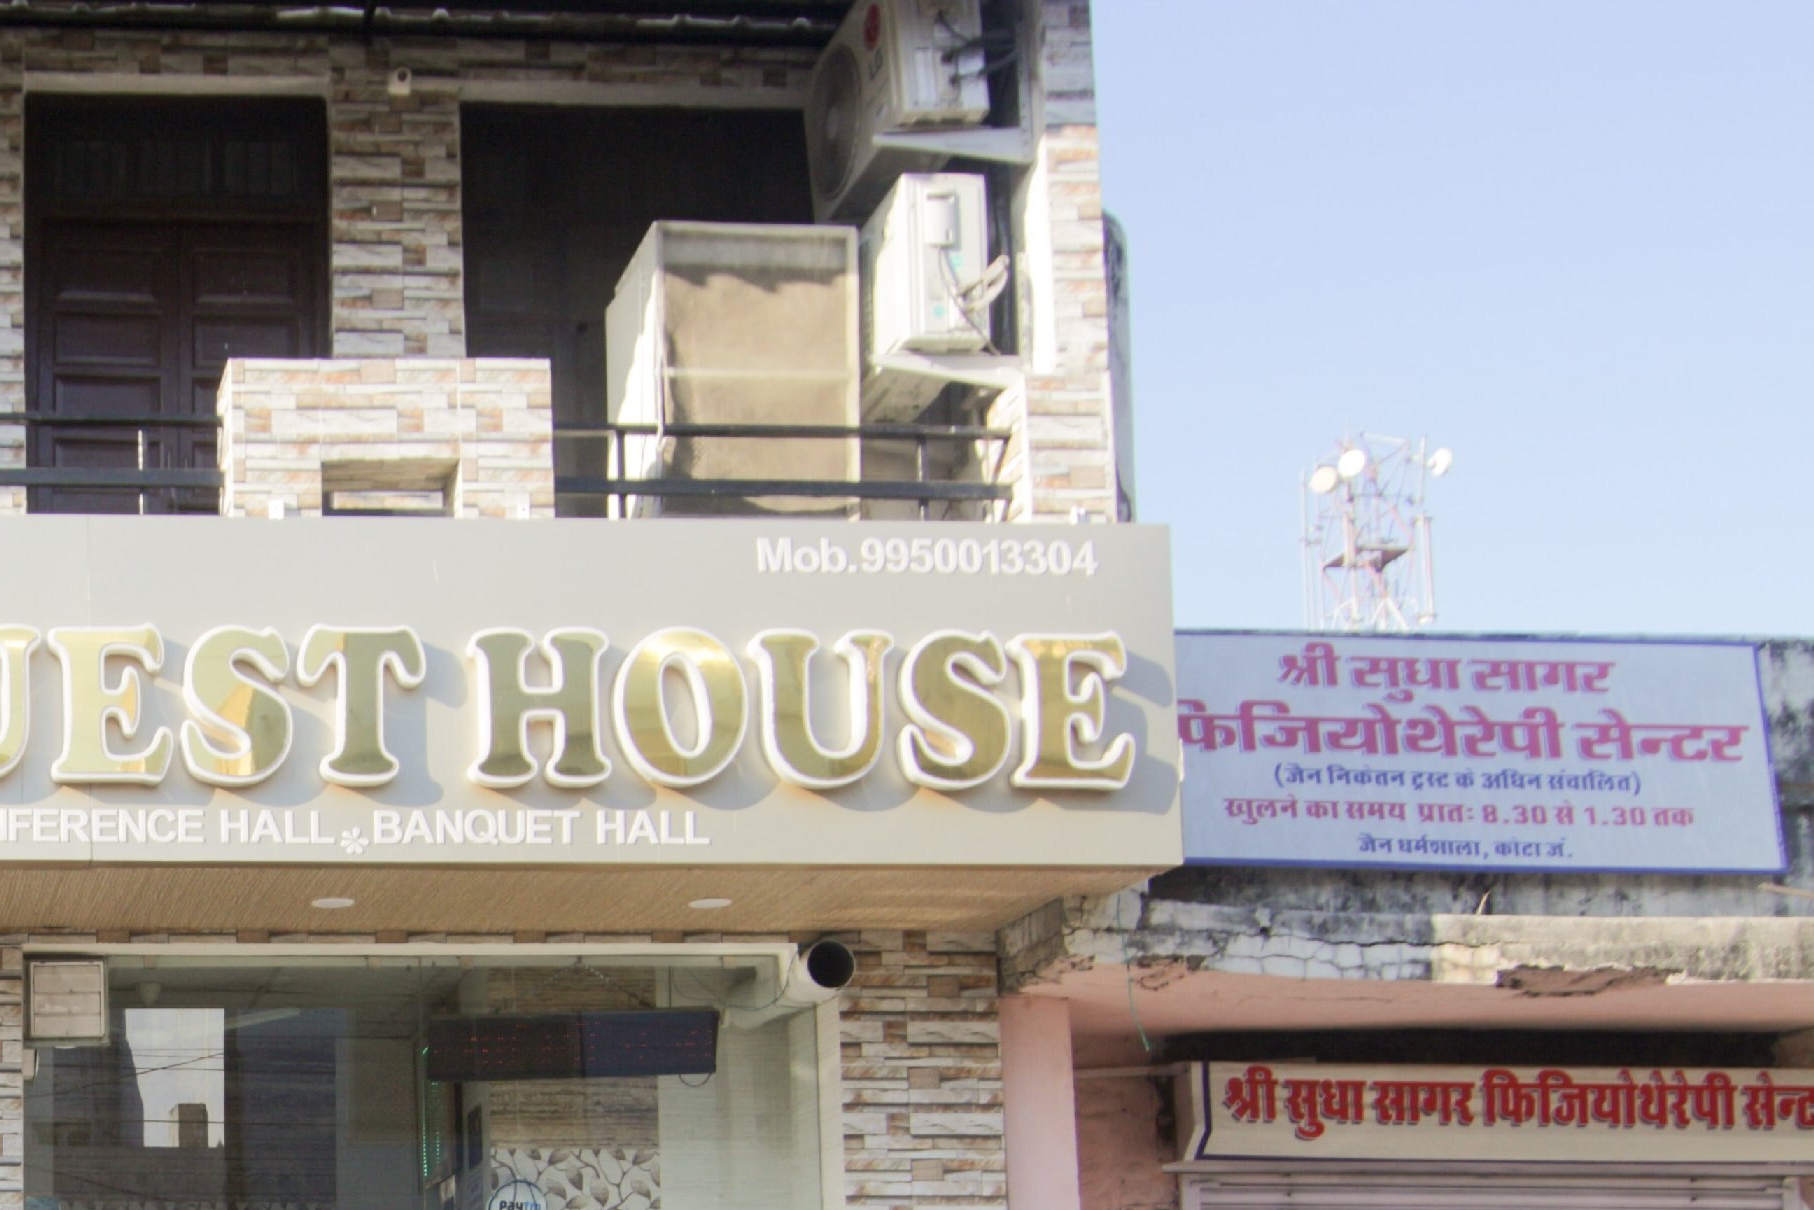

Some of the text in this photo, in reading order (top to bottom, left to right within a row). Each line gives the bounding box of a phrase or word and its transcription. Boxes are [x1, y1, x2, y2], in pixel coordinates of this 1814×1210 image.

[1277, 641, 1616, 703] श्री सुधा सागर
[467, 626, 1136, 793] HOUSE
[1573, 707, 1749, 762] सेन्टर
[220, 809, 335, 844] HALL
[373, 810, 580, 845] BANQUET
[596, 810, 711, 845] HALL
[1224, 794, 1298, 825] खुलने
[1304, 800, 1339, 818] का
[1346, 801, 1406, 821] समय
[1482, 804, 1547, 825] 8.30
[1553, 800, 1575, 825] से
[1584, 806, 1646, 826] 1.30
[1651, 807, 1695, 826] तक
[1358, 832, 1392, 853] जैन
[1494, 836, 1541, 857] कोटा
[1222, 1065, 1279, 1123] श्री
[1282, 1078, 1367, 1140] सुधा
[1369, 1080, 1476, 1125] सागर
[1480, 1068, 1738, 1130] फिजियोथेरेपी
